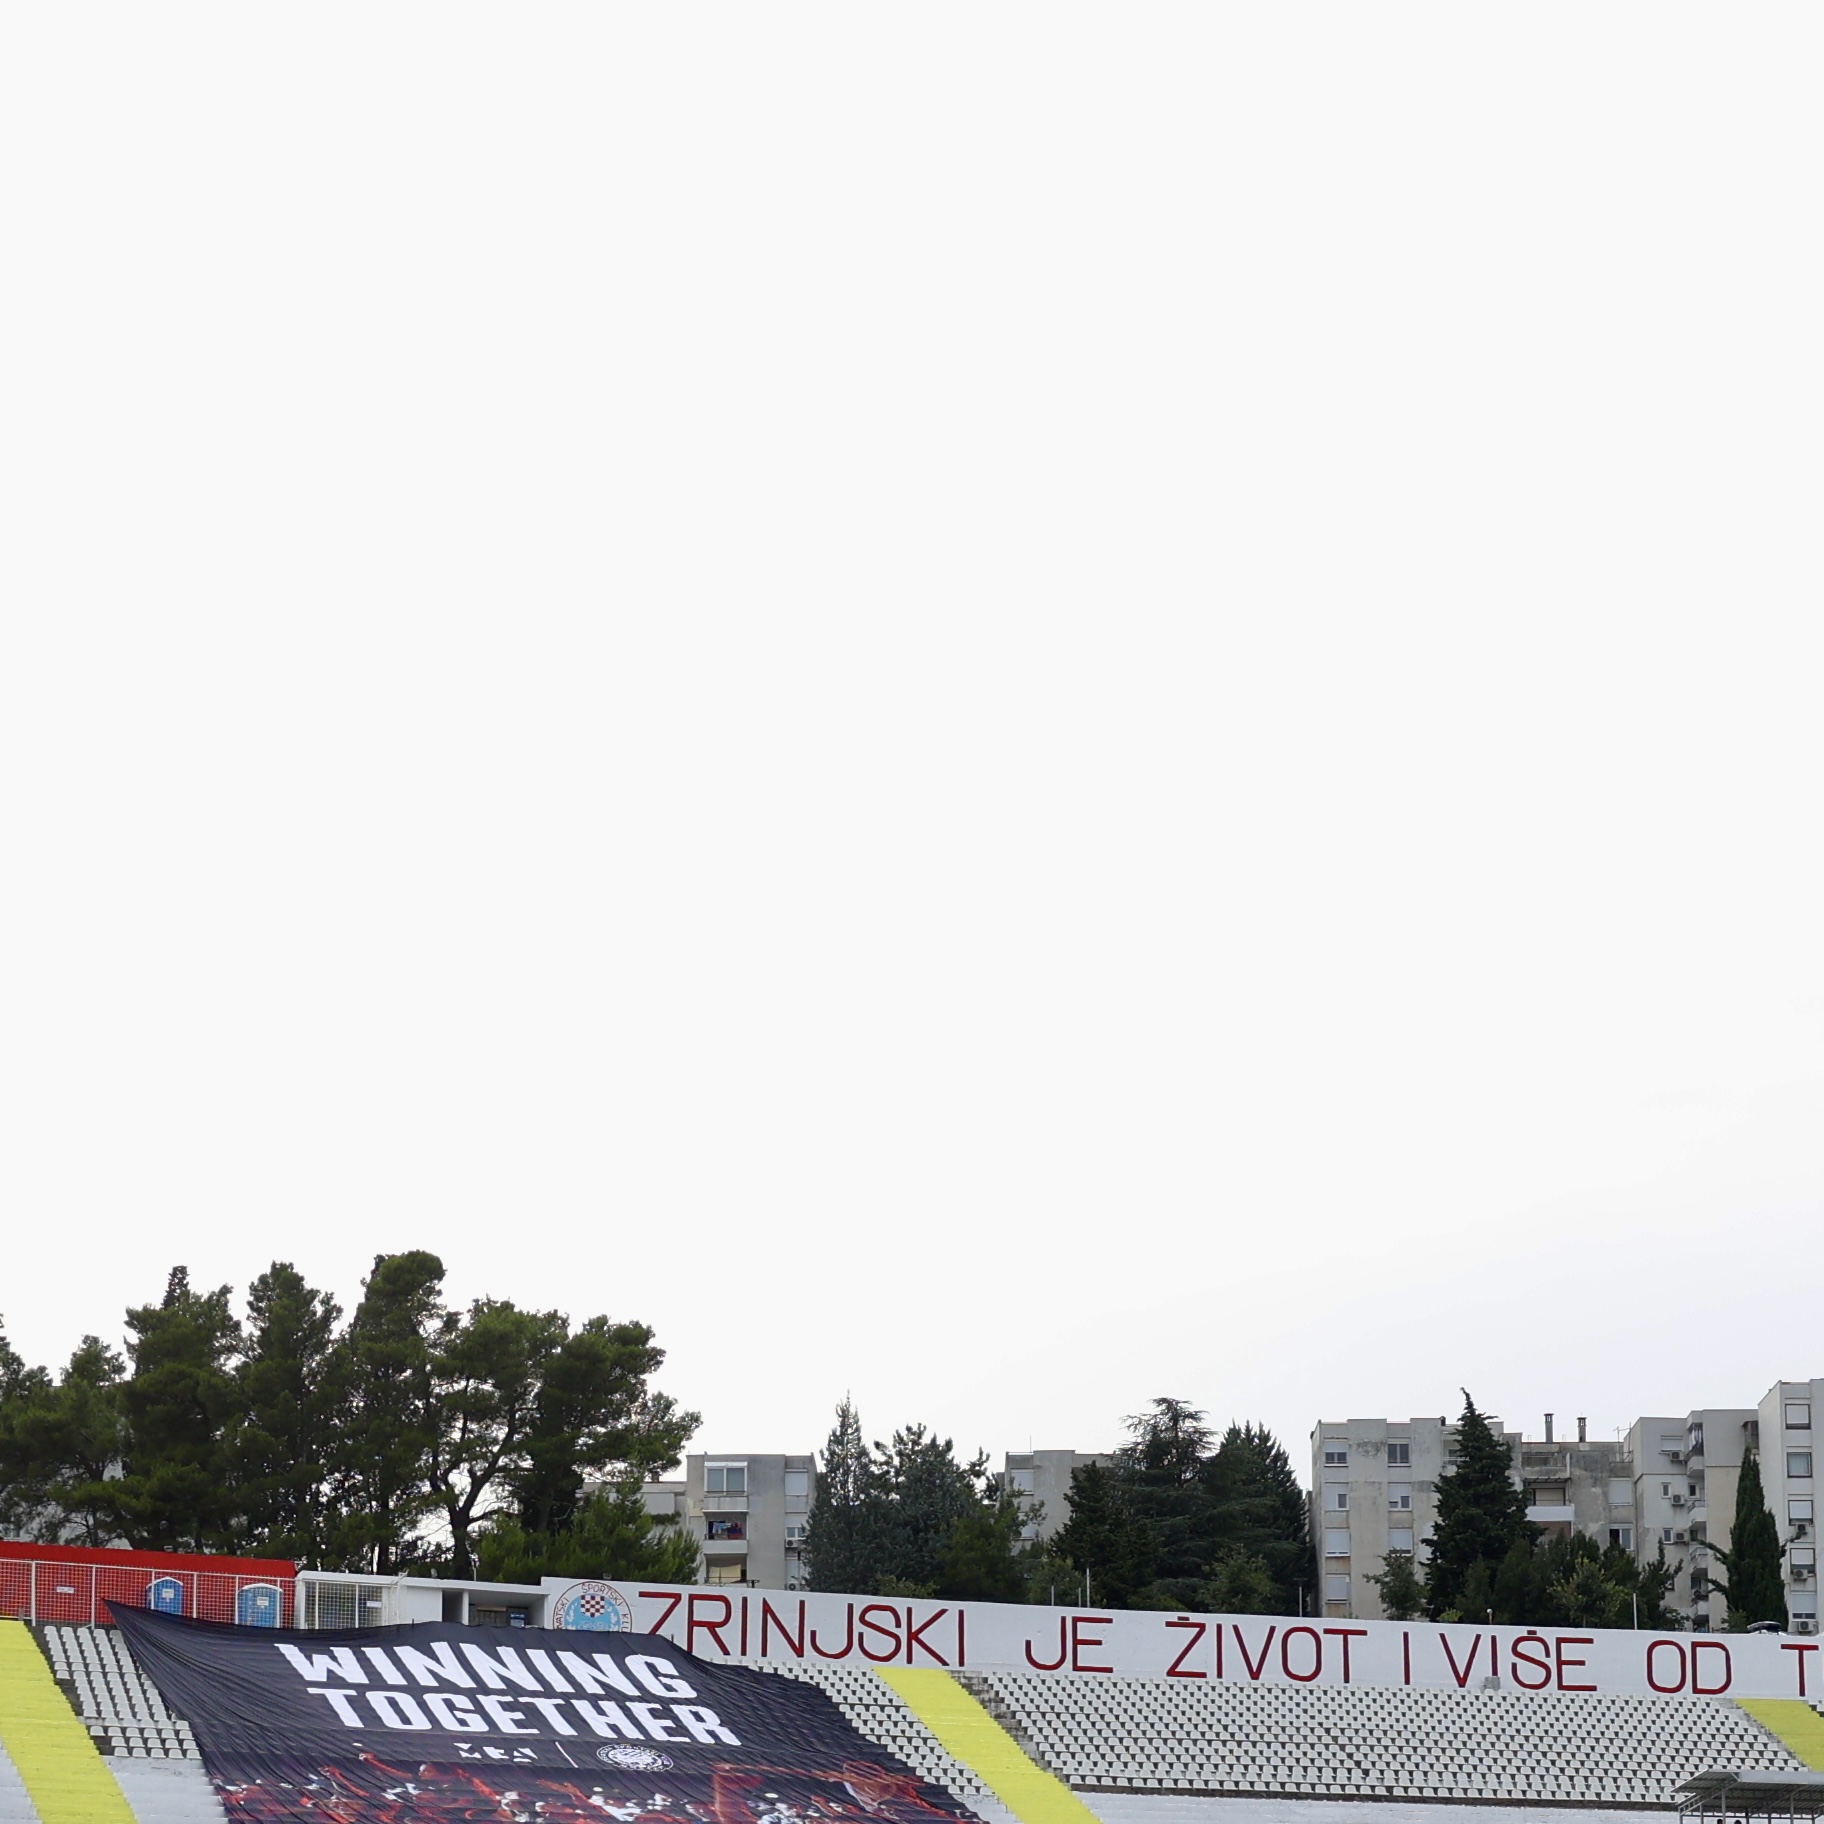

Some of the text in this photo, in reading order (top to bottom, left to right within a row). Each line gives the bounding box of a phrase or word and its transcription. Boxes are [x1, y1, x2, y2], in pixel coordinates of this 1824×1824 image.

[274, 1642, 697, 1698] WINNING
[639, 1591, 965, 1667] ZRINJSKI
[1026, 1616, 1113, 1673] JE
[1403, 1631, 1411, 1685] I
[1646, 1640, 1731, 1695] OD
[307, 1688, 741, 1745] TOGETHER
